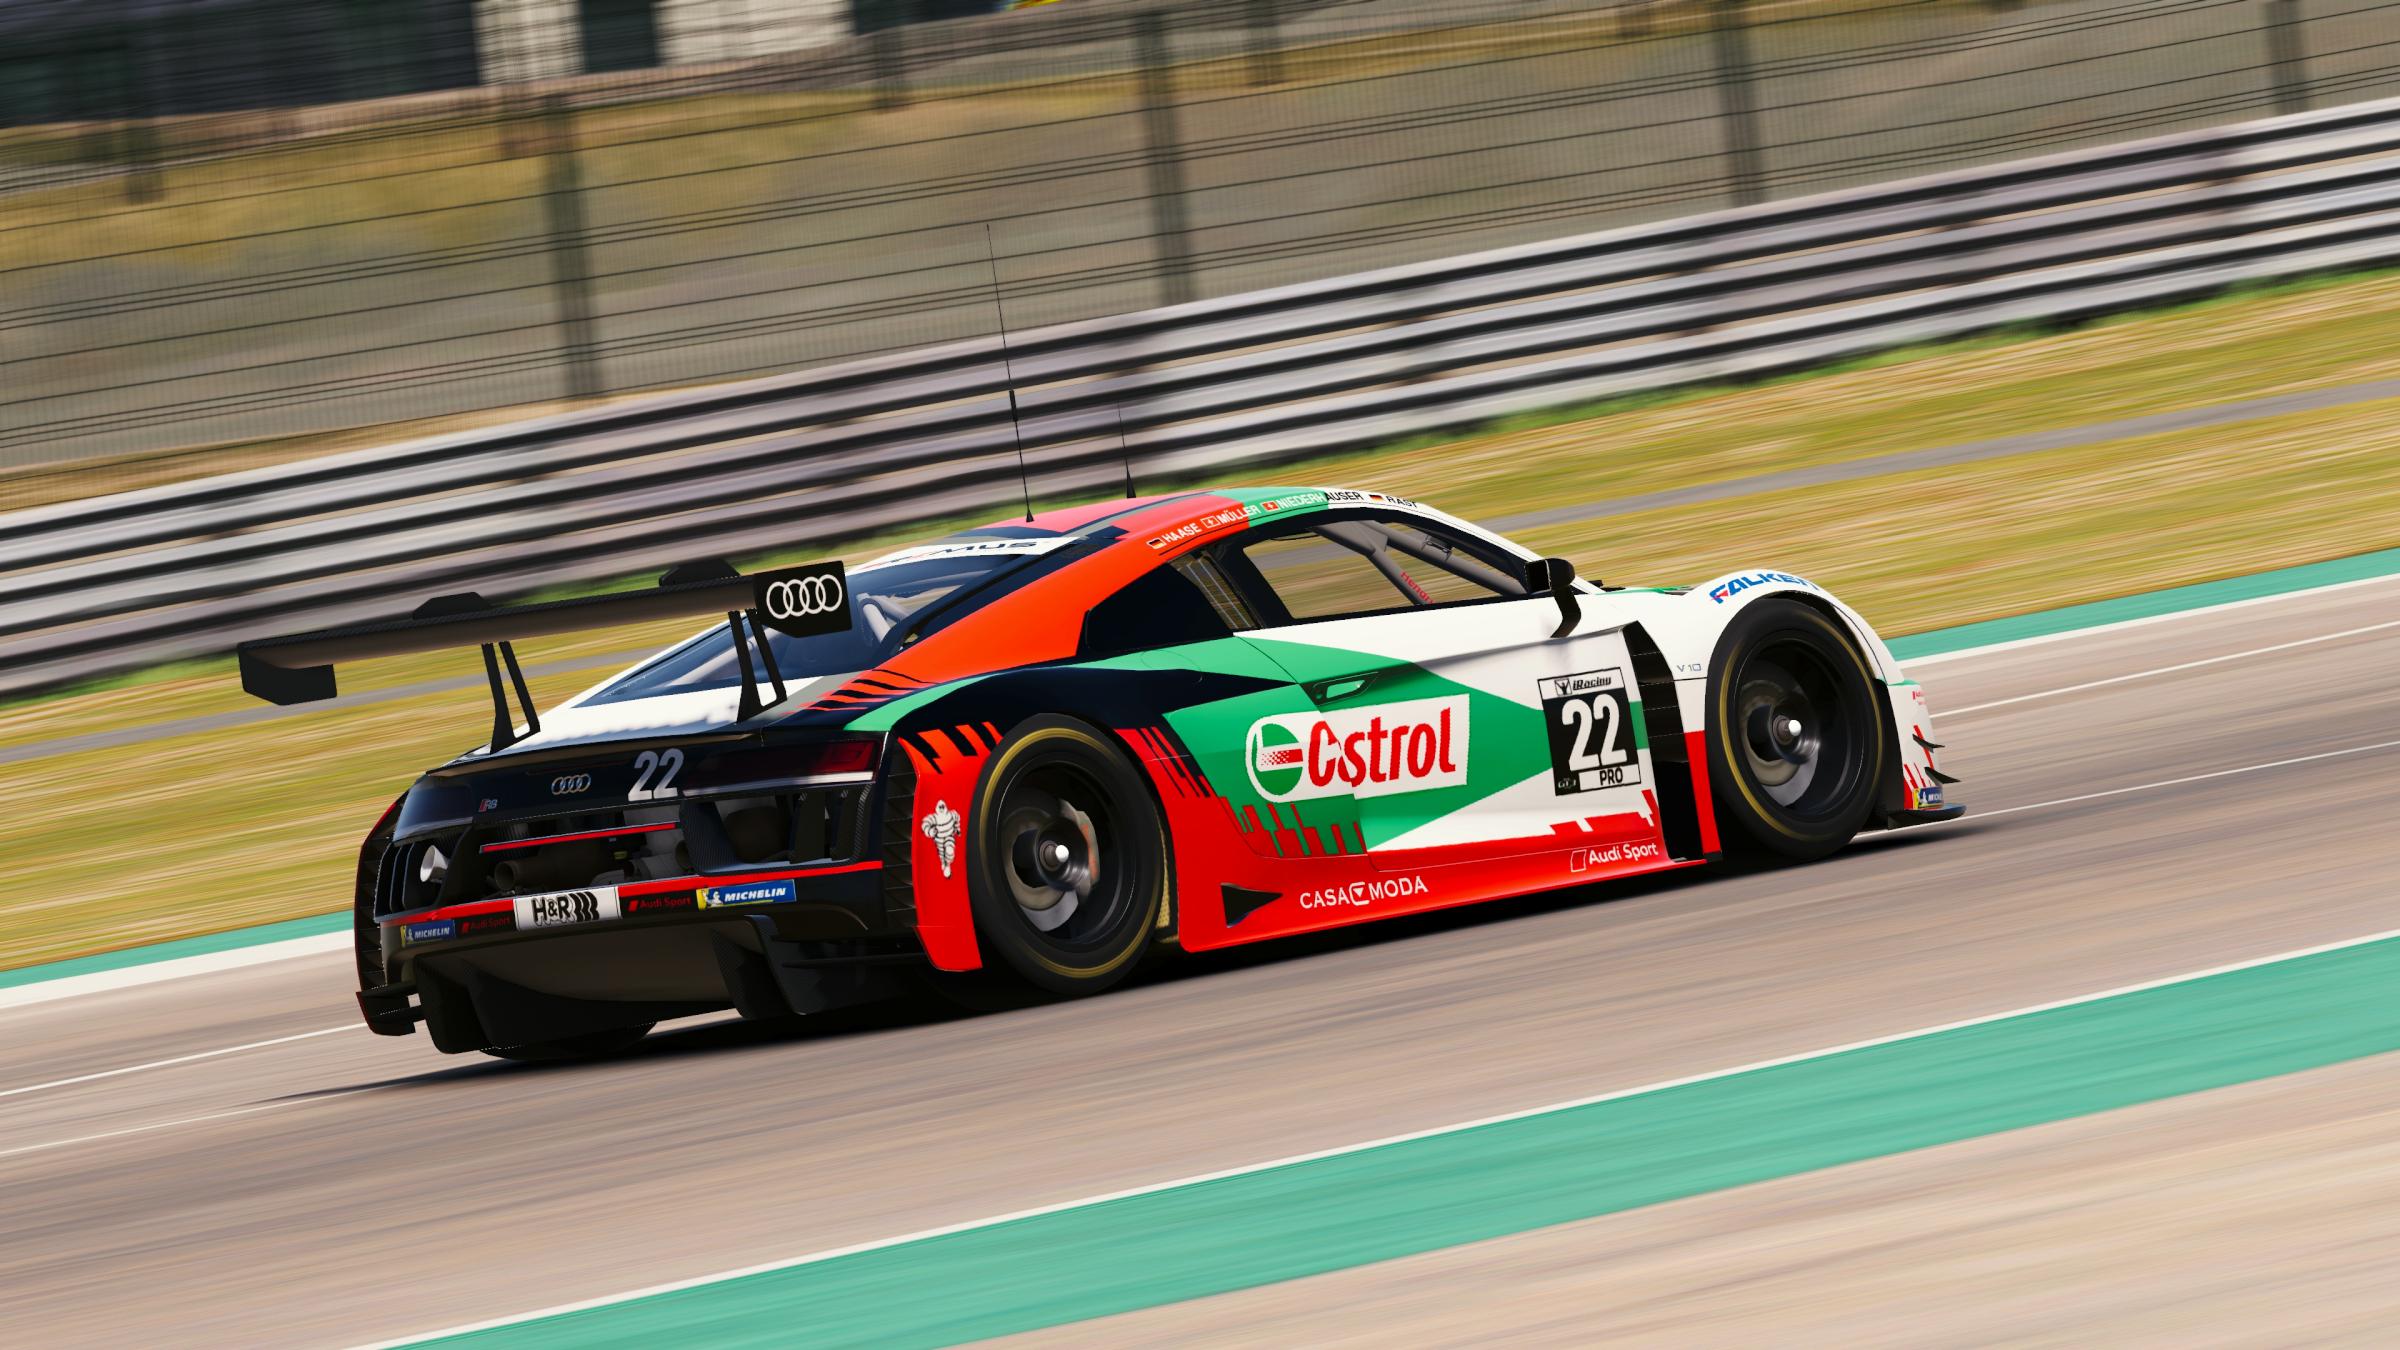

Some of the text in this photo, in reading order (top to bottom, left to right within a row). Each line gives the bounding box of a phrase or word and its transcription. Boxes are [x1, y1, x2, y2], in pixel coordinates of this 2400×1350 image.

[1163, 491, 1418, 544] HAASE MÜLLER NIEDERHAUSER RAST
[1572, 676, 1612, 691] iRacing
[1561, 693, 1628, 772] 22
[627, 748, 685, 801] 22
[1599, 767, 1624, 786] PRO
[1588, 843, 1659, 864] Audi Sport
[724, 887, 787, 903] MICHELIN
[532, 894, 573, 925] H&R
[414, 926, 450, 939] MICHELIN
